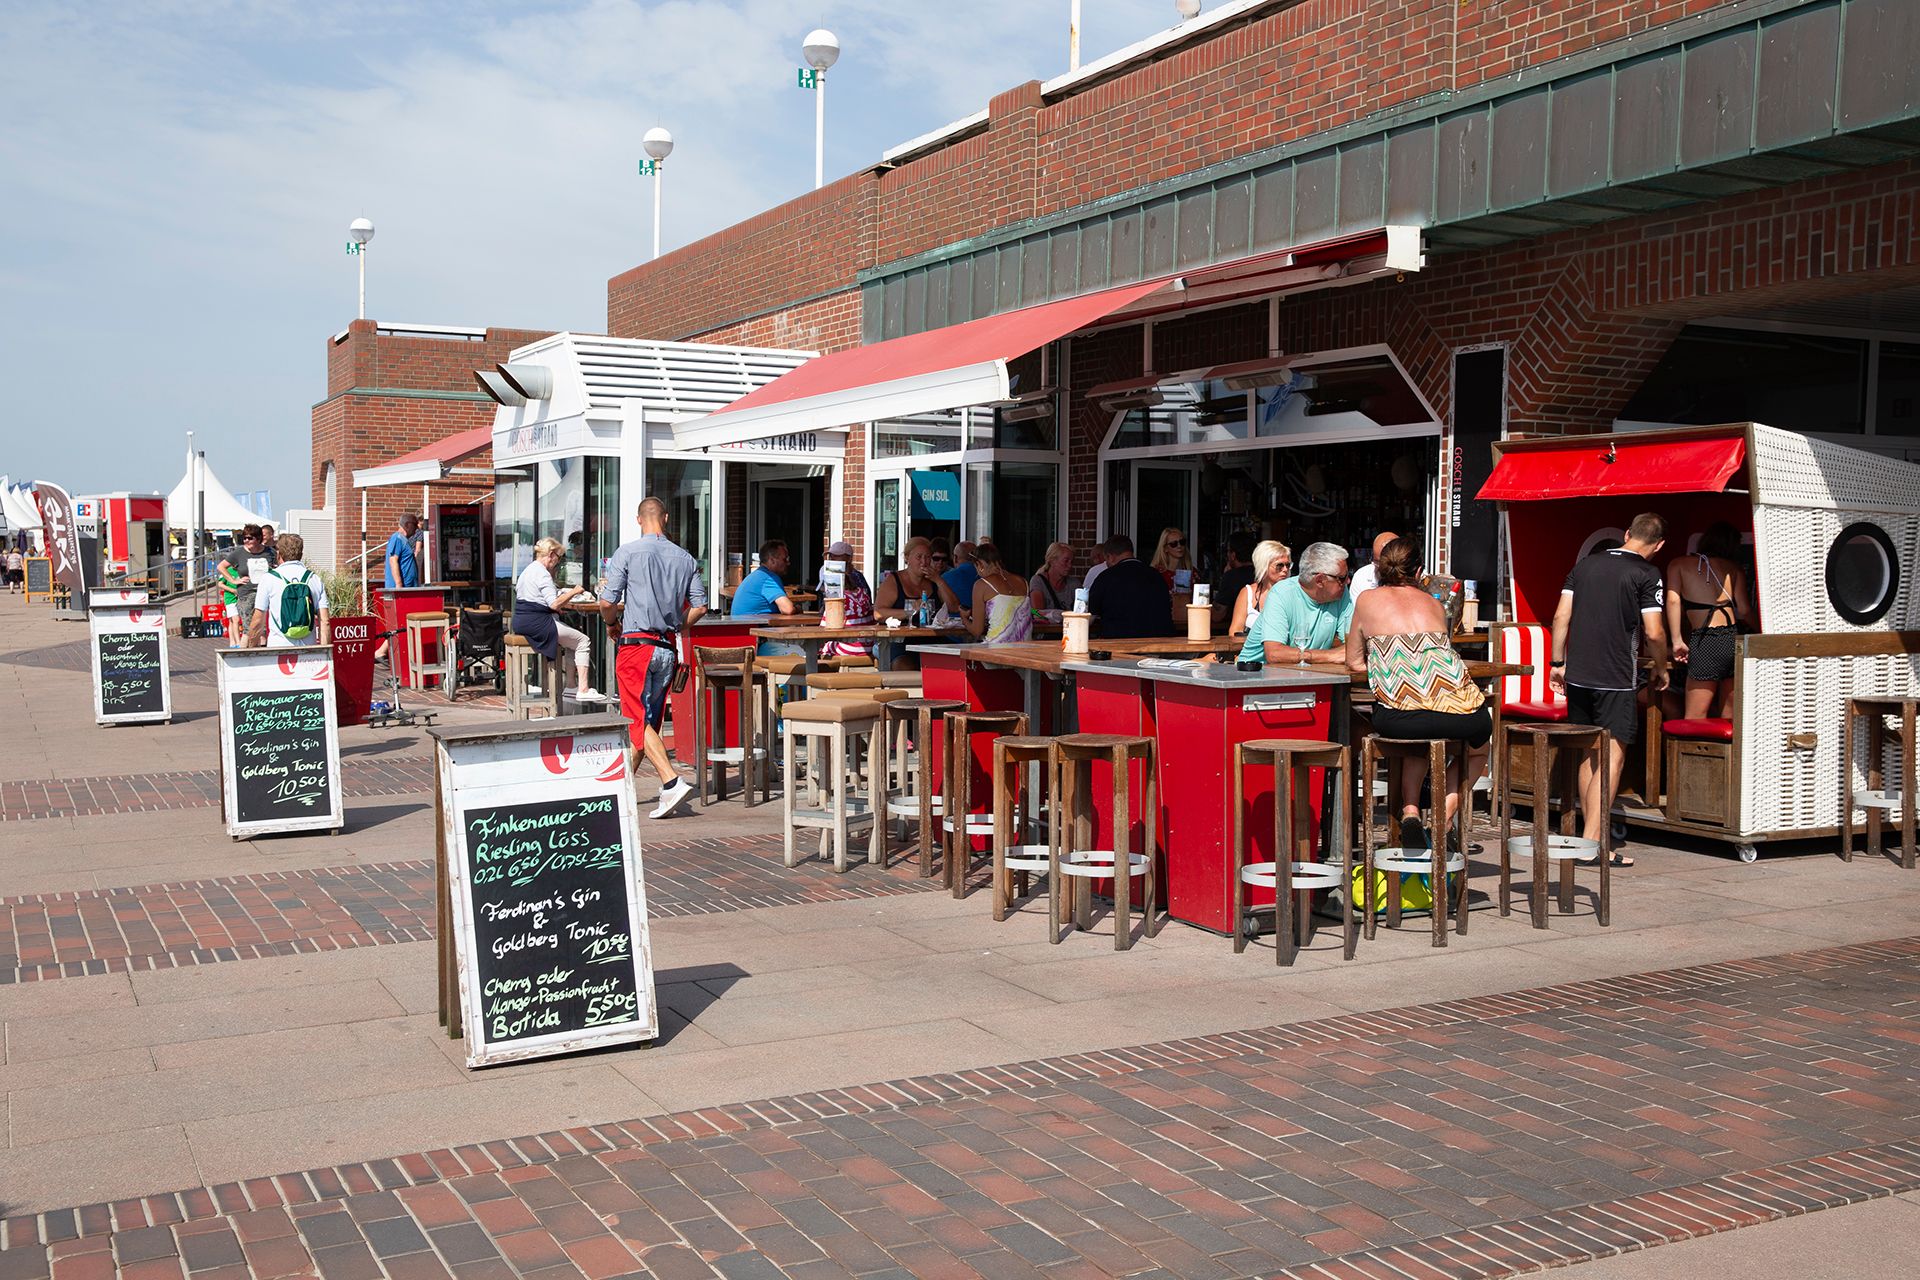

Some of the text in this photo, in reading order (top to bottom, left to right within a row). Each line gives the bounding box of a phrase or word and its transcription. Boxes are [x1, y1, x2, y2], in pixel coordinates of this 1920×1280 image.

[803, 69, 811, 78] B
[801, 79, 814, 88] 11
[640, 168, 653, 176] 12
[761, 433, 817, 452] STRAND
[1453, 446, 1463, 486] GOSCH
[922, 489, 950, 501] GIN SUL
[77, 504, 91, 516] EC
[1452, 494, 1461, 527] STRAND
[102, 632, 158, 644] Cherry Batida
[334, 624, 368, 639] GOSCH
[338, 643, 364, 657] SYLT
[236, 692, 324, 711] Finkenauer 2018
[245, 704, 320, 722] Riesling Löss
[240, 738, 320, 756] Ferdinan's Gin
[576, 742, 613, 755] GOSCH
[269, 753, 279, 763] &
[241, 759, 324, 780] Goldberg Tonic
[470, 799, 612, 841] Finkenauer 2018
[476, 828, 590, 864] Riesling Löss
[480, 888, 601, 921] Ferdinan's Gin
[533, 912, 550, 929] &
[492, 921, 610, 959] Goldberg Tonic
[484, 965, 575, 996] Cherry oder
[492, 1007, 562, 1038] Batida
